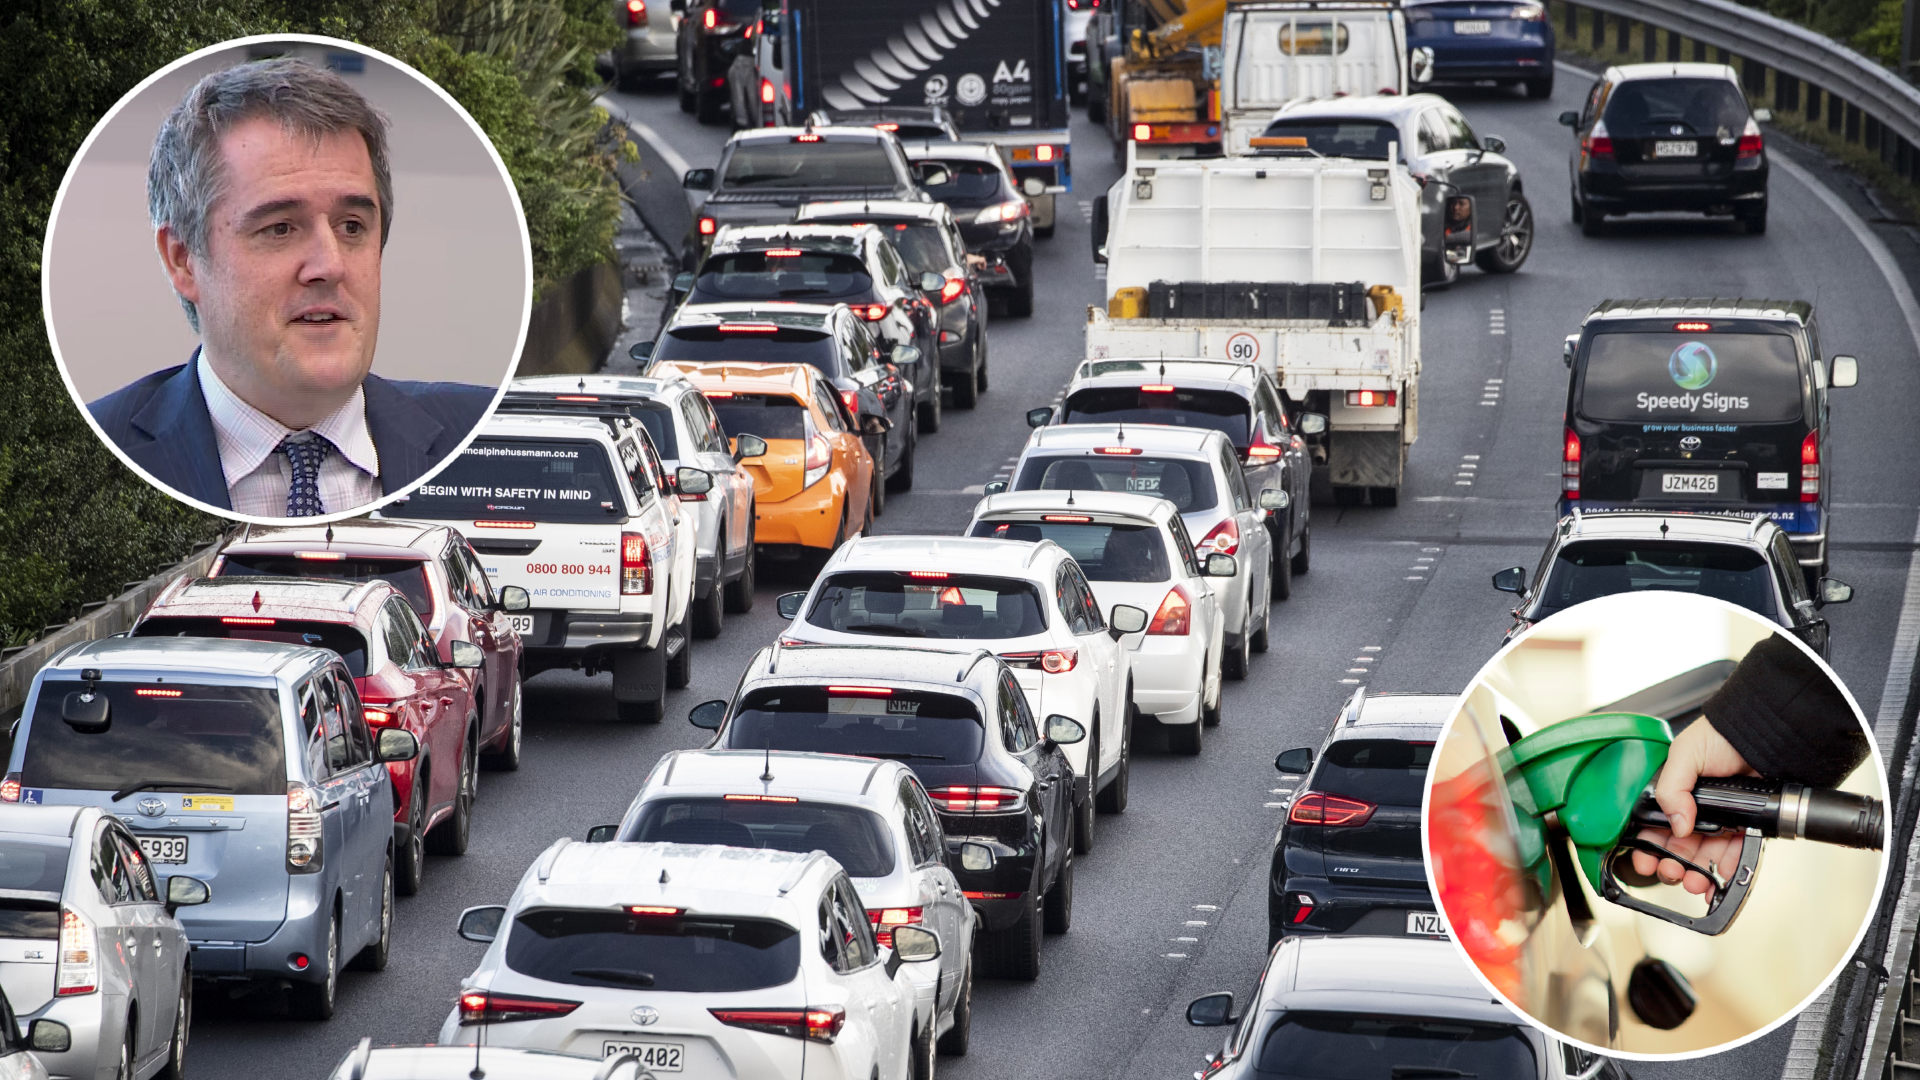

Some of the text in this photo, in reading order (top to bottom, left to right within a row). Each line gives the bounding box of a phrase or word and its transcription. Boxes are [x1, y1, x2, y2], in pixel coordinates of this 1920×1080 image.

[993, 60, 1030, 83] A4
[1233, 344, 1253, 359] 90
[1637, 392, 1749, 412] Speedy Signs
[1643, 424, 1662, 432] grow
[1681, 424, 1714, 432] business
[1715, 424, 1738, 432] faster
[1665, 477, 1716, 490] JZM426
[419, 486, 592, 500] BEGIN WITH SAFETY IN MIND
[526, 563, 611, 575] 0800 800 944
[534, 588, 548, 596] AIR
[551, 589, 611, 598] CONDITIONING
[507, 617, 531, 631] 09
